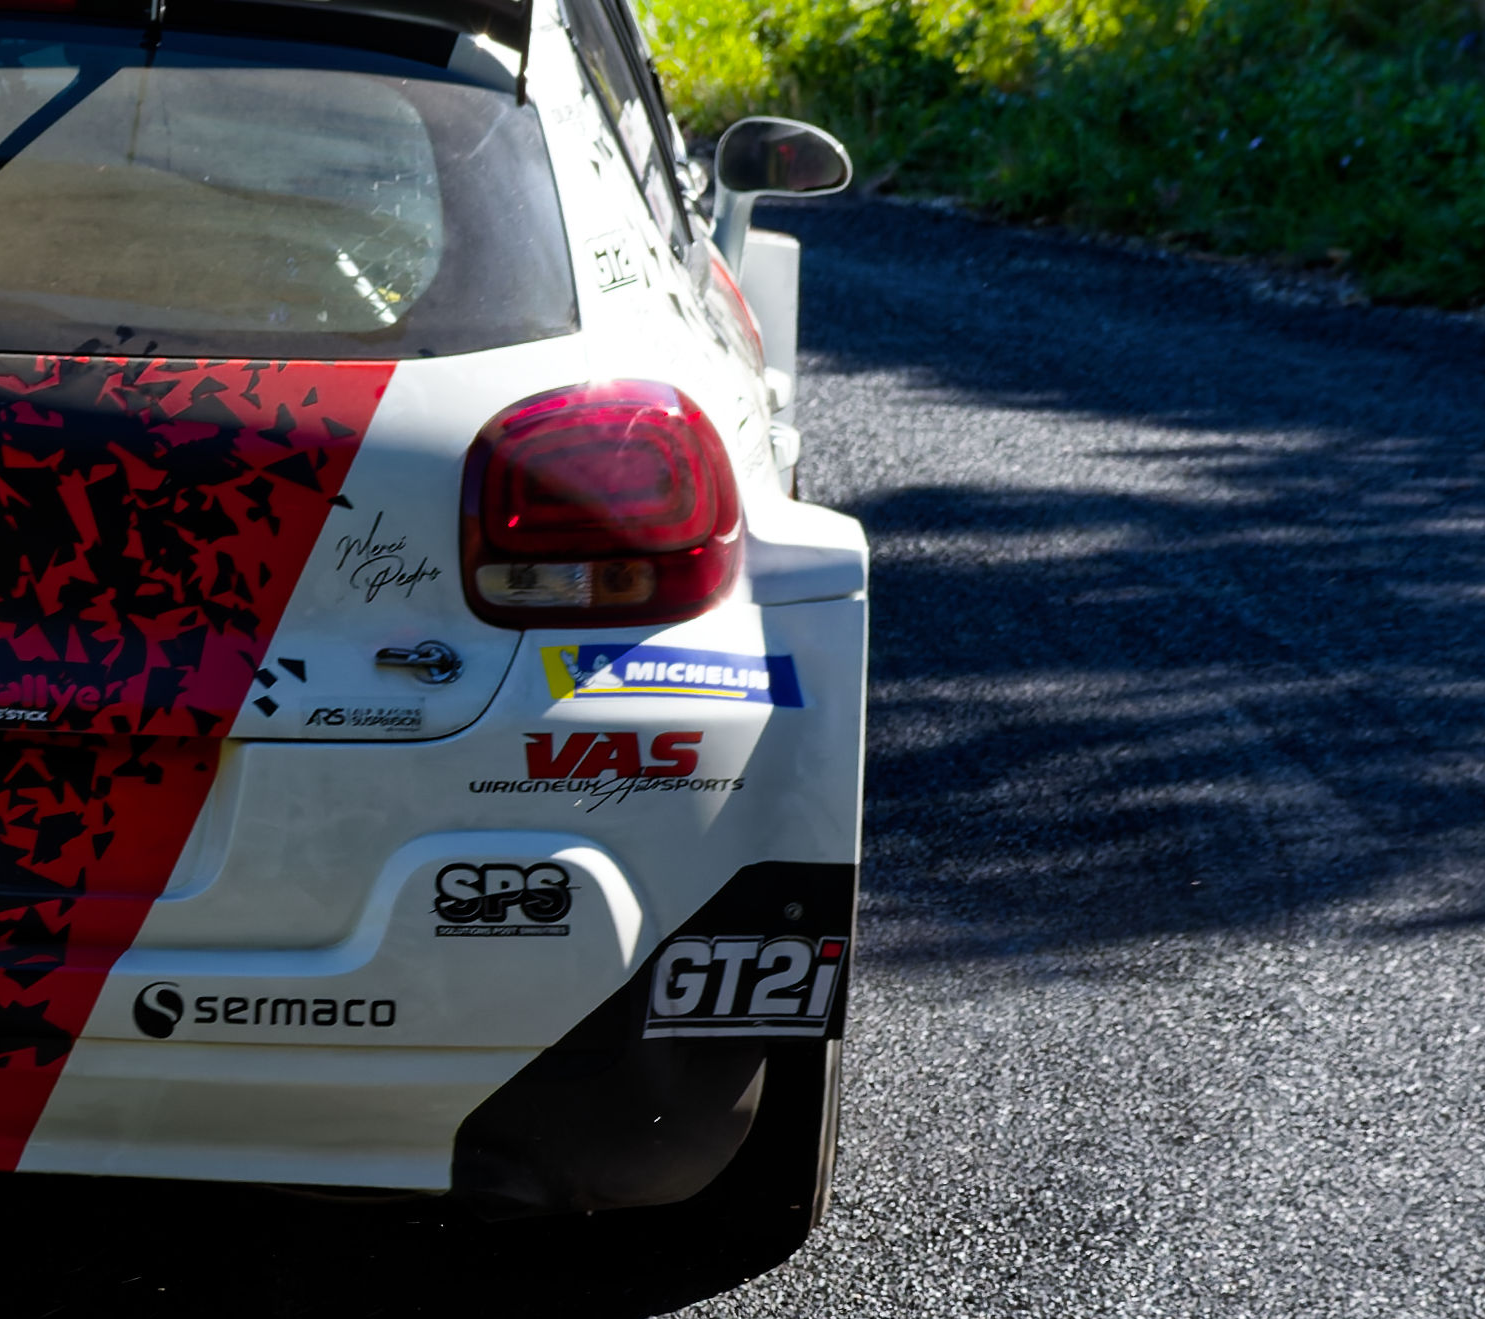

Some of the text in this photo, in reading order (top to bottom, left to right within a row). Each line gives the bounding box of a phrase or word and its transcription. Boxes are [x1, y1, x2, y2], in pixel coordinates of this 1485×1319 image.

[335, 511, 407, 570] Merci
[624, 660, 771, 690] MICHELIN
[523, 731, 703, 779] VAS
[434, 862, 572, 923] SPS
[653, 940, 842, 1017] GT2i
[193, 996, 396, 1027] sermaco
